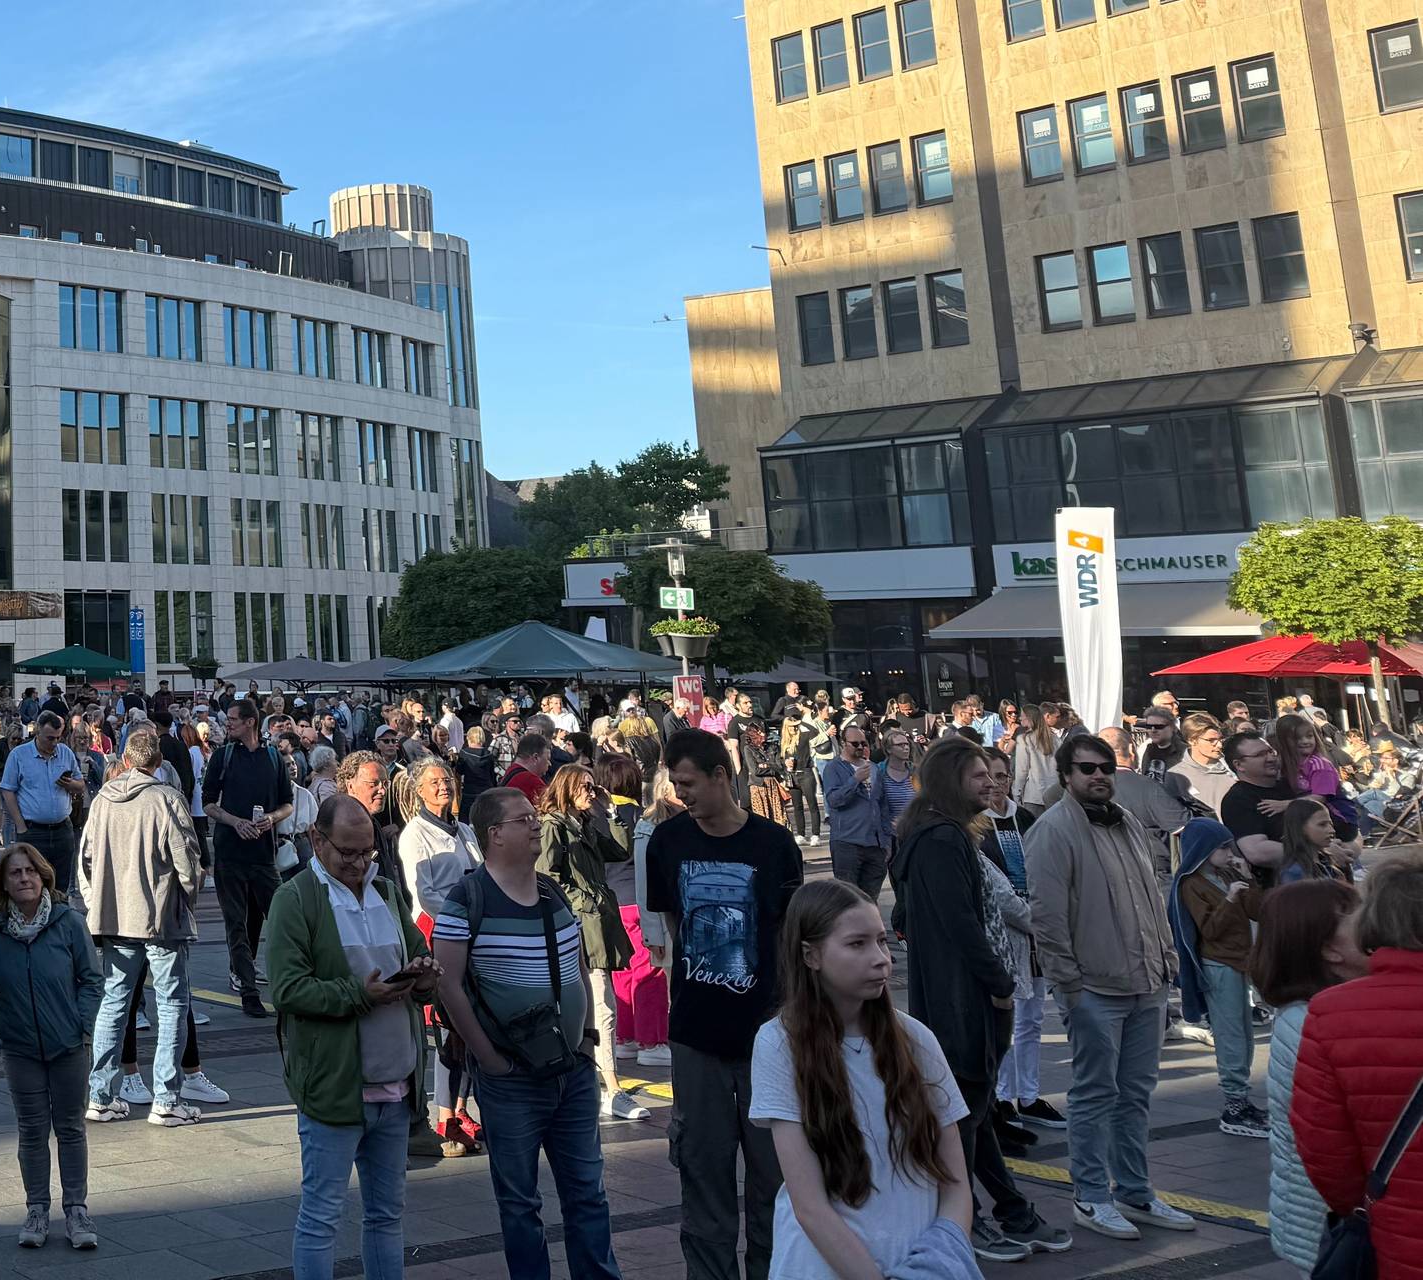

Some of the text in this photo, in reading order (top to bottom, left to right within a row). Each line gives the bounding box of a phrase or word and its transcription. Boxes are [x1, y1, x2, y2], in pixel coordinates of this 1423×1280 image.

[1010, 551, 1229, 576] kas SCHMAUSER
[1074, 535, 1099, 609] WDR 4
[680, 680, 700, 693] WC
[682, 955, 758, 994] Venezia
